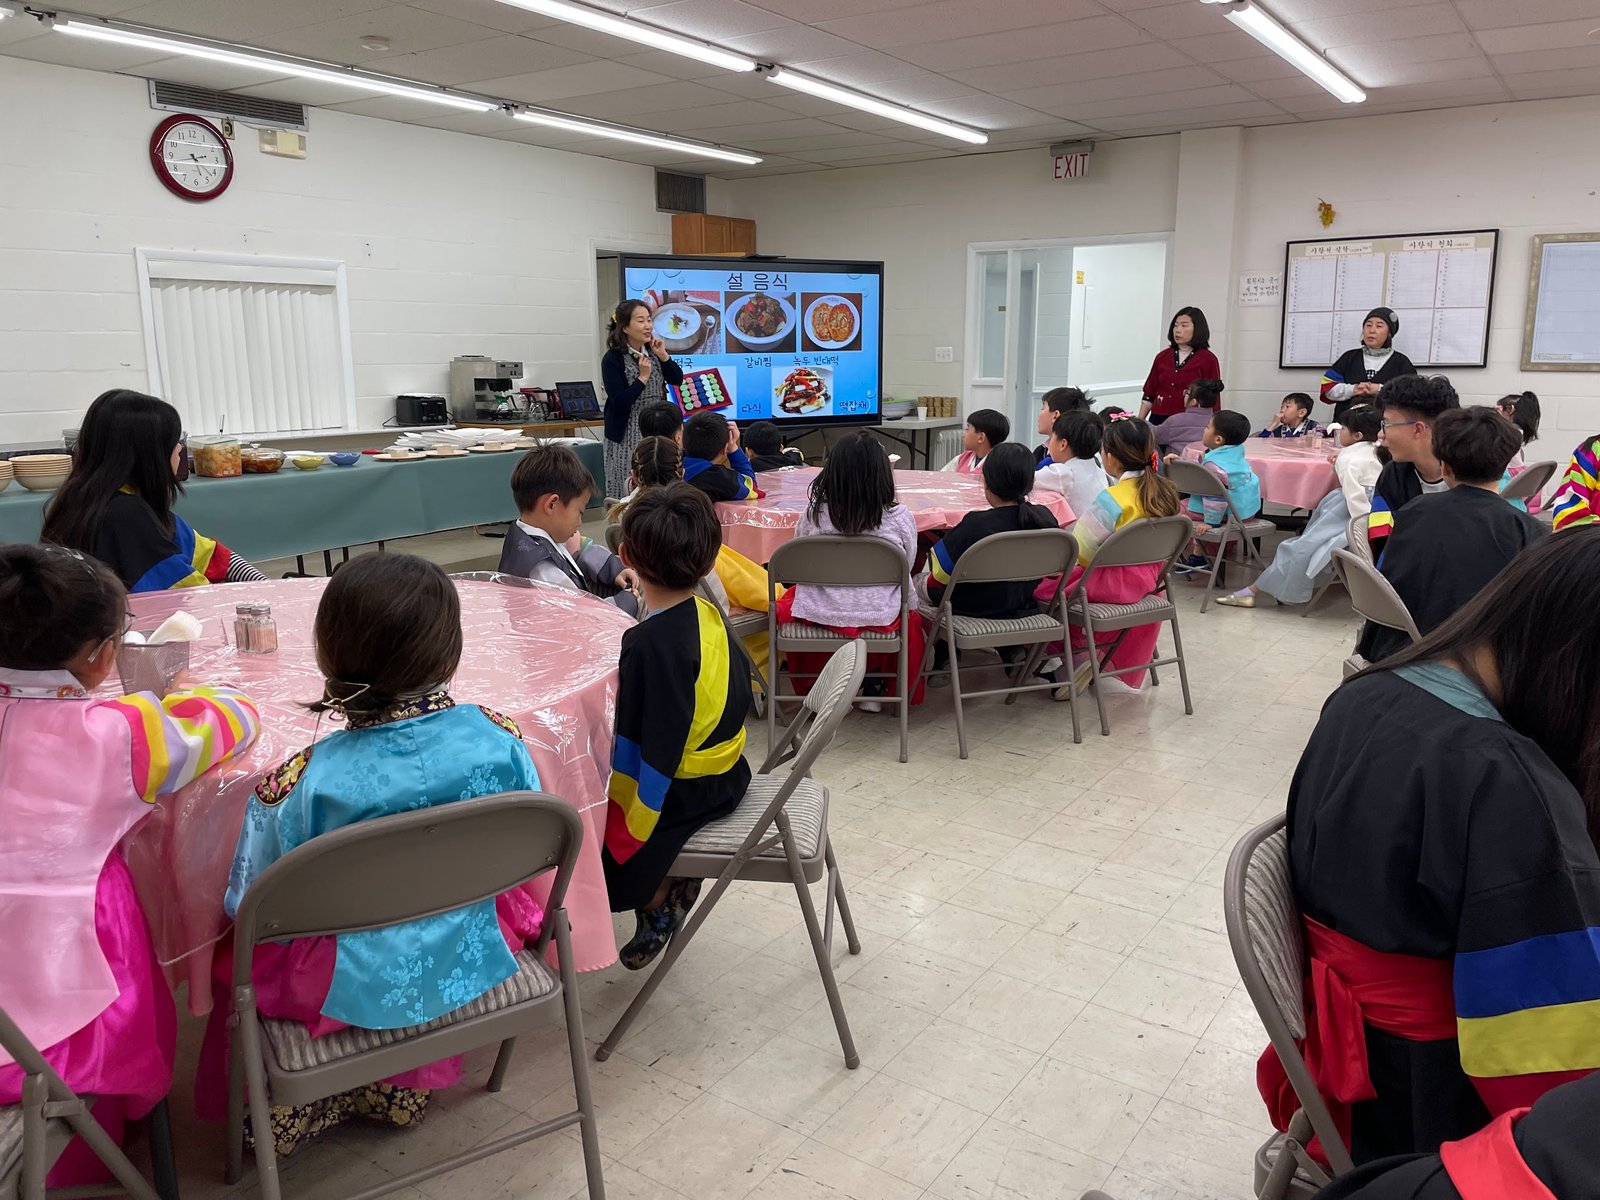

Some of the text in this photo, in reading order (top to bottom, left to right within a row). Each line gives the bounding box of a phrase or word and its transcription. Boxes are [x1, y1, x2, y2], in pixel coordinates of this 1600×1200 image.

[178, 132, 185, 140] 11
[188, 130, 196, 138] 12
[1054, 153, 1089, 179] EXIT
[727, 272, 788, 291] 설 음식
[793, 355, 839, 366] 녹두 빈대떡
[741, 402, 762, 414] 다식
[838, 400, 867, 412] 떡잡채
